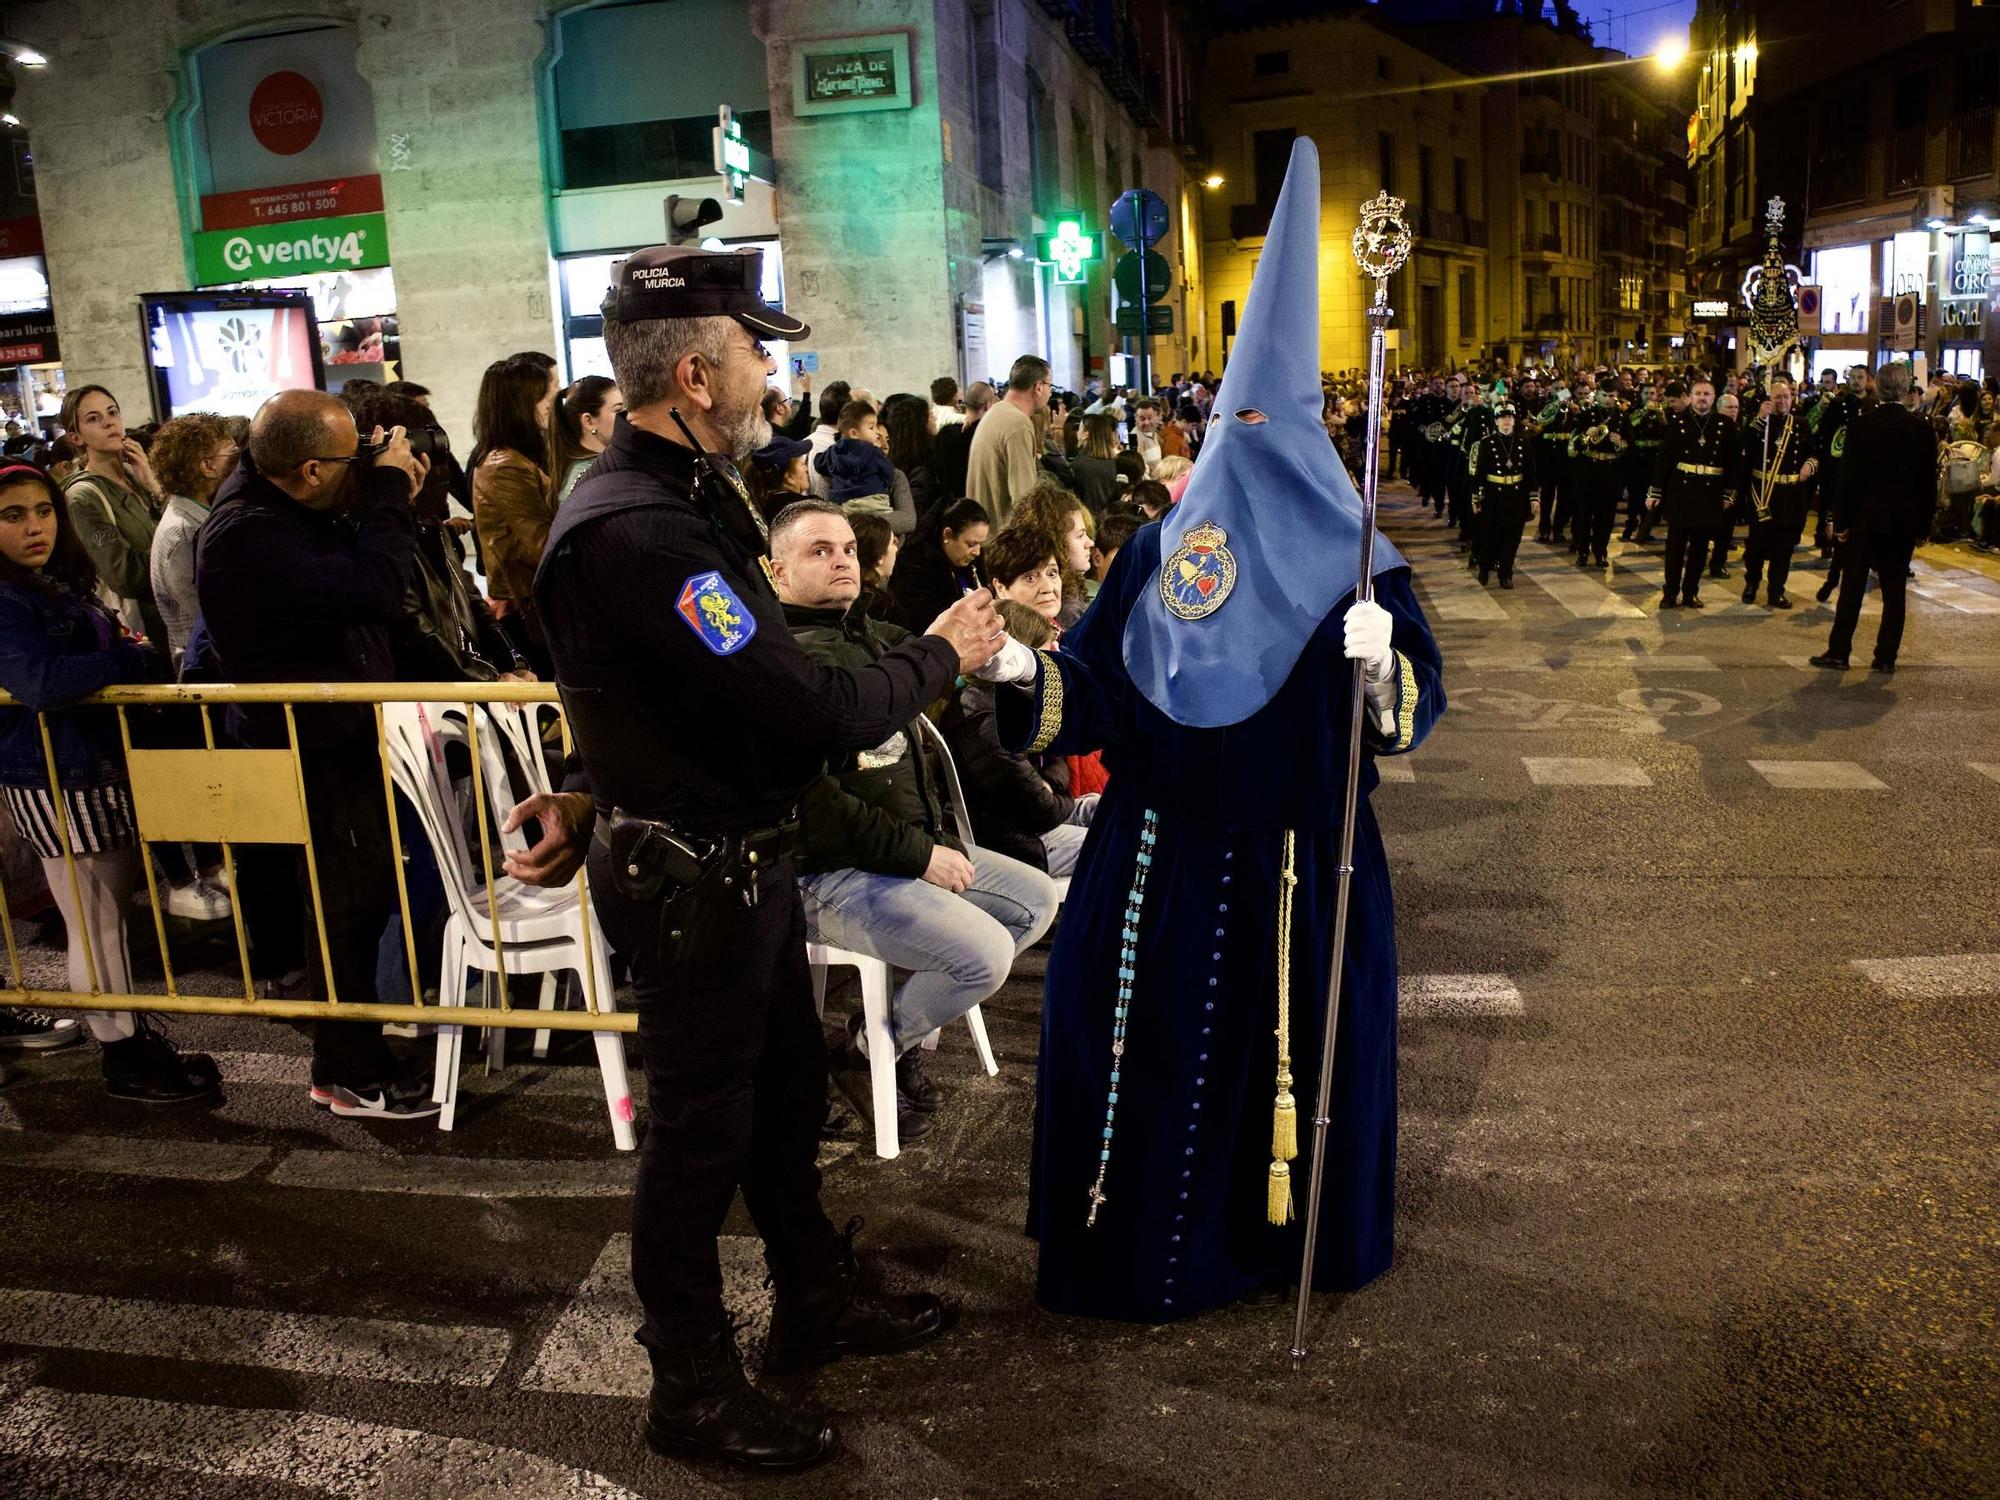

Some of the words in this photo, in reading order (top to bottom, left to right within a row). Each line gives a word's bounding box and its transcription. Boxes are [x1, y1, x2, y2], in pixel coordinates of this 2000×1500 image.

[869, 60, 887, 72] DE
[254, 107, 319, 128] VICTORIA
[267, 203, 289, 216] 645
[291, 201, 312, 213] 801
[316, 198, 337, 210] 500
[633, 268, 669, 280] POLICIA
[645, 277, 686, 289] MURCIA
[1941, 300, 1981, 326] iGold
